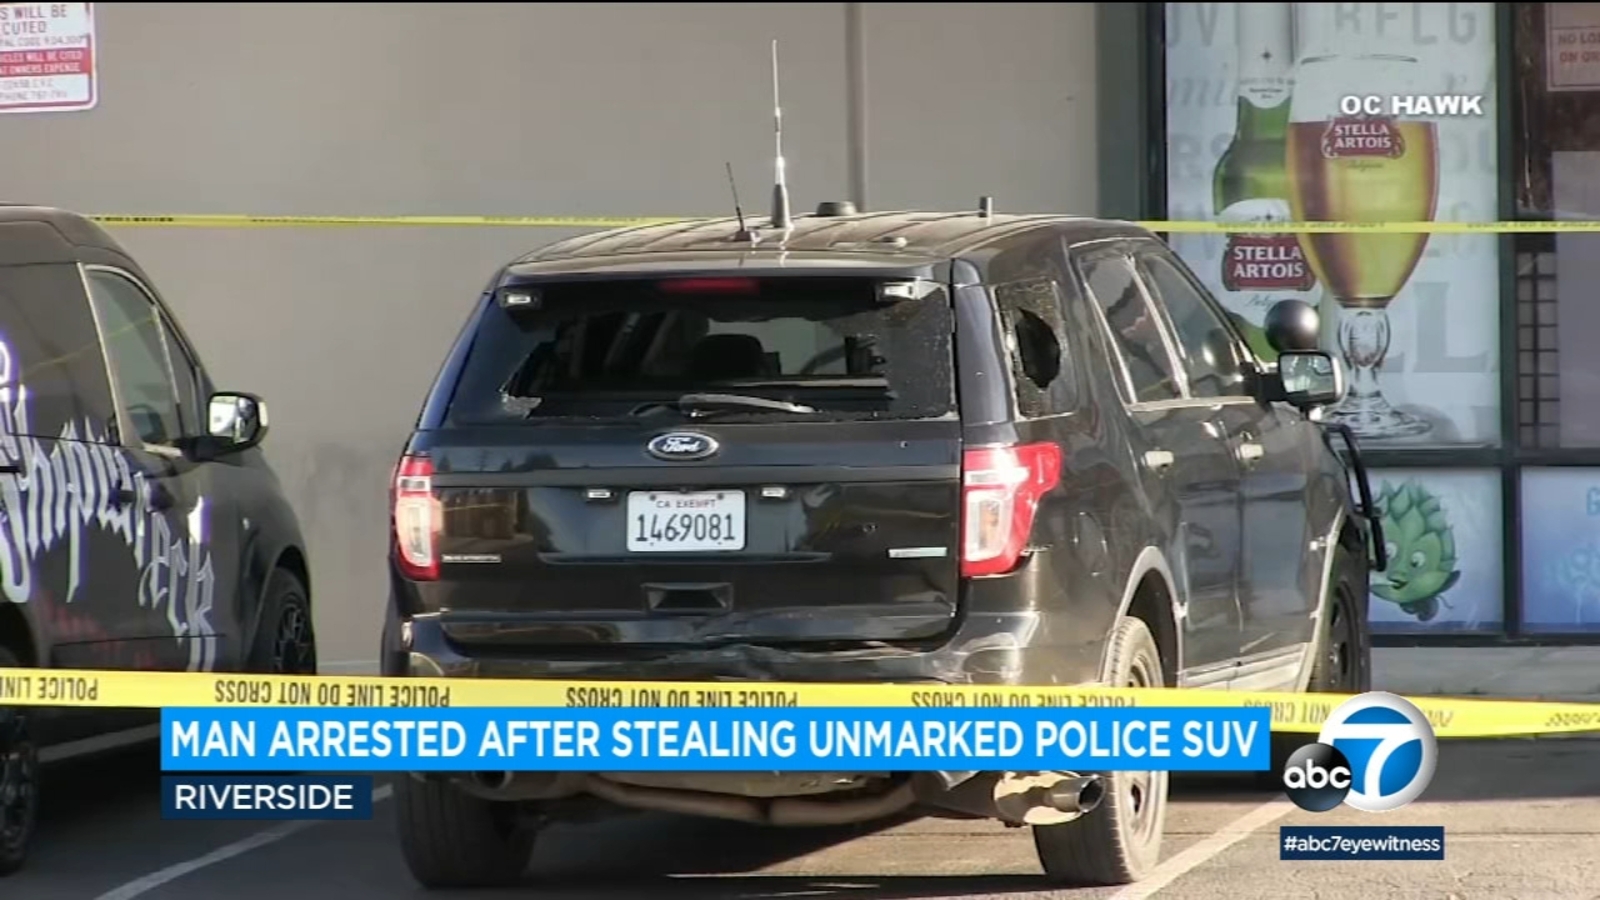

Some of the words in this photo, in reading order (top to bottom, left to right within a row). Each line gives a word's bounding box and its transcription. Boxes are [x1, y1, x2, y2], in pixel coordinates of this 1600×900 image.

[14, 7, 46, 18] WILL
[51, 5, 67, 18] BE
[1334, 125, 1390, 136] STELLA
[1334, 137, 1391, 149] ARTOIS
[1233, 246, 1301, 260] STELLA
[1233, 263, 1304, 278] ARTOIS
[662, 437, 701, 452] Ford
[656, 500, 671, 509] CA
[676, 499, 716, 509] EXEMPT
[636, 513, 736, 543] 1469081
[38, 677, 98, 700] POLICE
[214, 680, 271, 703] CROSS
[277, 682, 310, 705] NOT
[318, 683, 340, 706] DO
[346, 684, 383, 707] LINE
[390, 685, 450, 707] POLICE
[566, 687, 622, 707] CROSS
[631, 688, 661, 707] NOT
